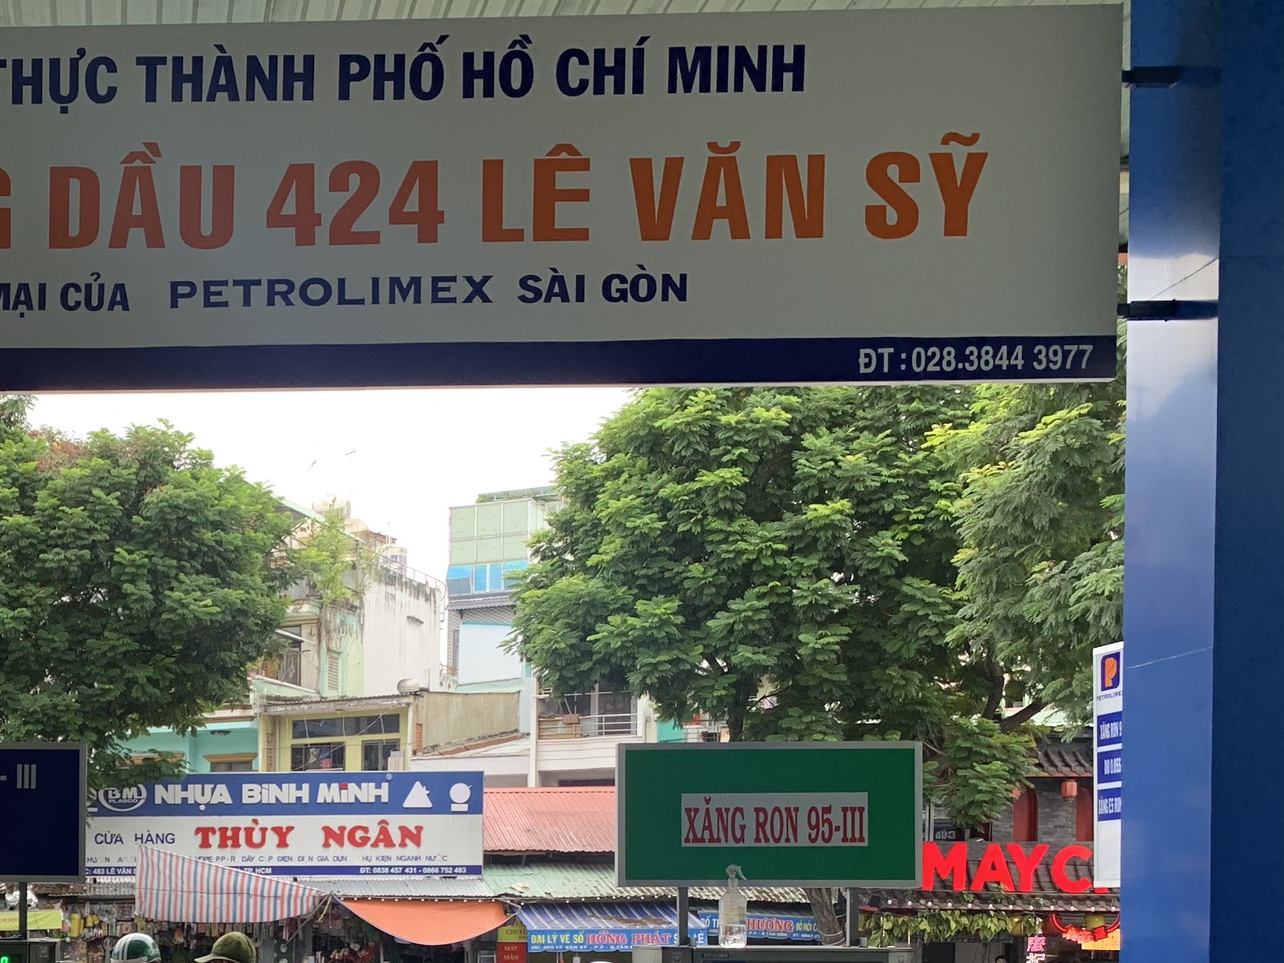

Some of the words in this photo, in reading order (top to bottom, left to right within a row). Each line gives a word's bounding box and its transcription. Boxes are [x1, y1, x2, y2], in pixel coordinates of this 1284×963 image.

[136, 44, 314, 102] THÀNH
[339, 36, 448, 100] PHỐ
[463, 34, 534, 98] HỒ
[556, 36, 649, 96] CHÍ
[668, 45, 805, 93] MINH
[49, 143, 234, 249] DẦU
[268, 161, 444, 245] 424
[483, 144, 590, 242] LÊ
[630, 142, 825, 241] VĂN
[865, 132, 988, 239] SỸ
[60, 272, 129, 311] CỦA
[170, 278, 493, 308] PETROLIMEX
[519, 268, 585, 303] SÀI
[602, 264, 687, 302] GÒN
[1032, 345, 1093, 370] 3977
[17, 763, 37, 789] III
[154, 783, 233, 811] NHỰA
[94, 830, 124, 845] CỬA
[134, 829, 176, 845] HÀNG
[195, 818, 295, 849] THÙY
[321, 818, 424, 849] NGÂN
[684, 797, 746, 845] XĂNG
[754, 806, 799, 844] RON
[807, 805, 865, 844] 95-III
[106, 867, 116, 875] LÊ
[116, 867, 132, 875] VĂN
[921, 841, 1109, 894] MAYC
[530, 932, 545, 945] ĐẠI
[547, 931, 557, 944] LÝ
[560, 931, 570, 944] VÉ
[573, 930, 585, 944] SỐ
[586, 930, 628, 945] HỒNG
